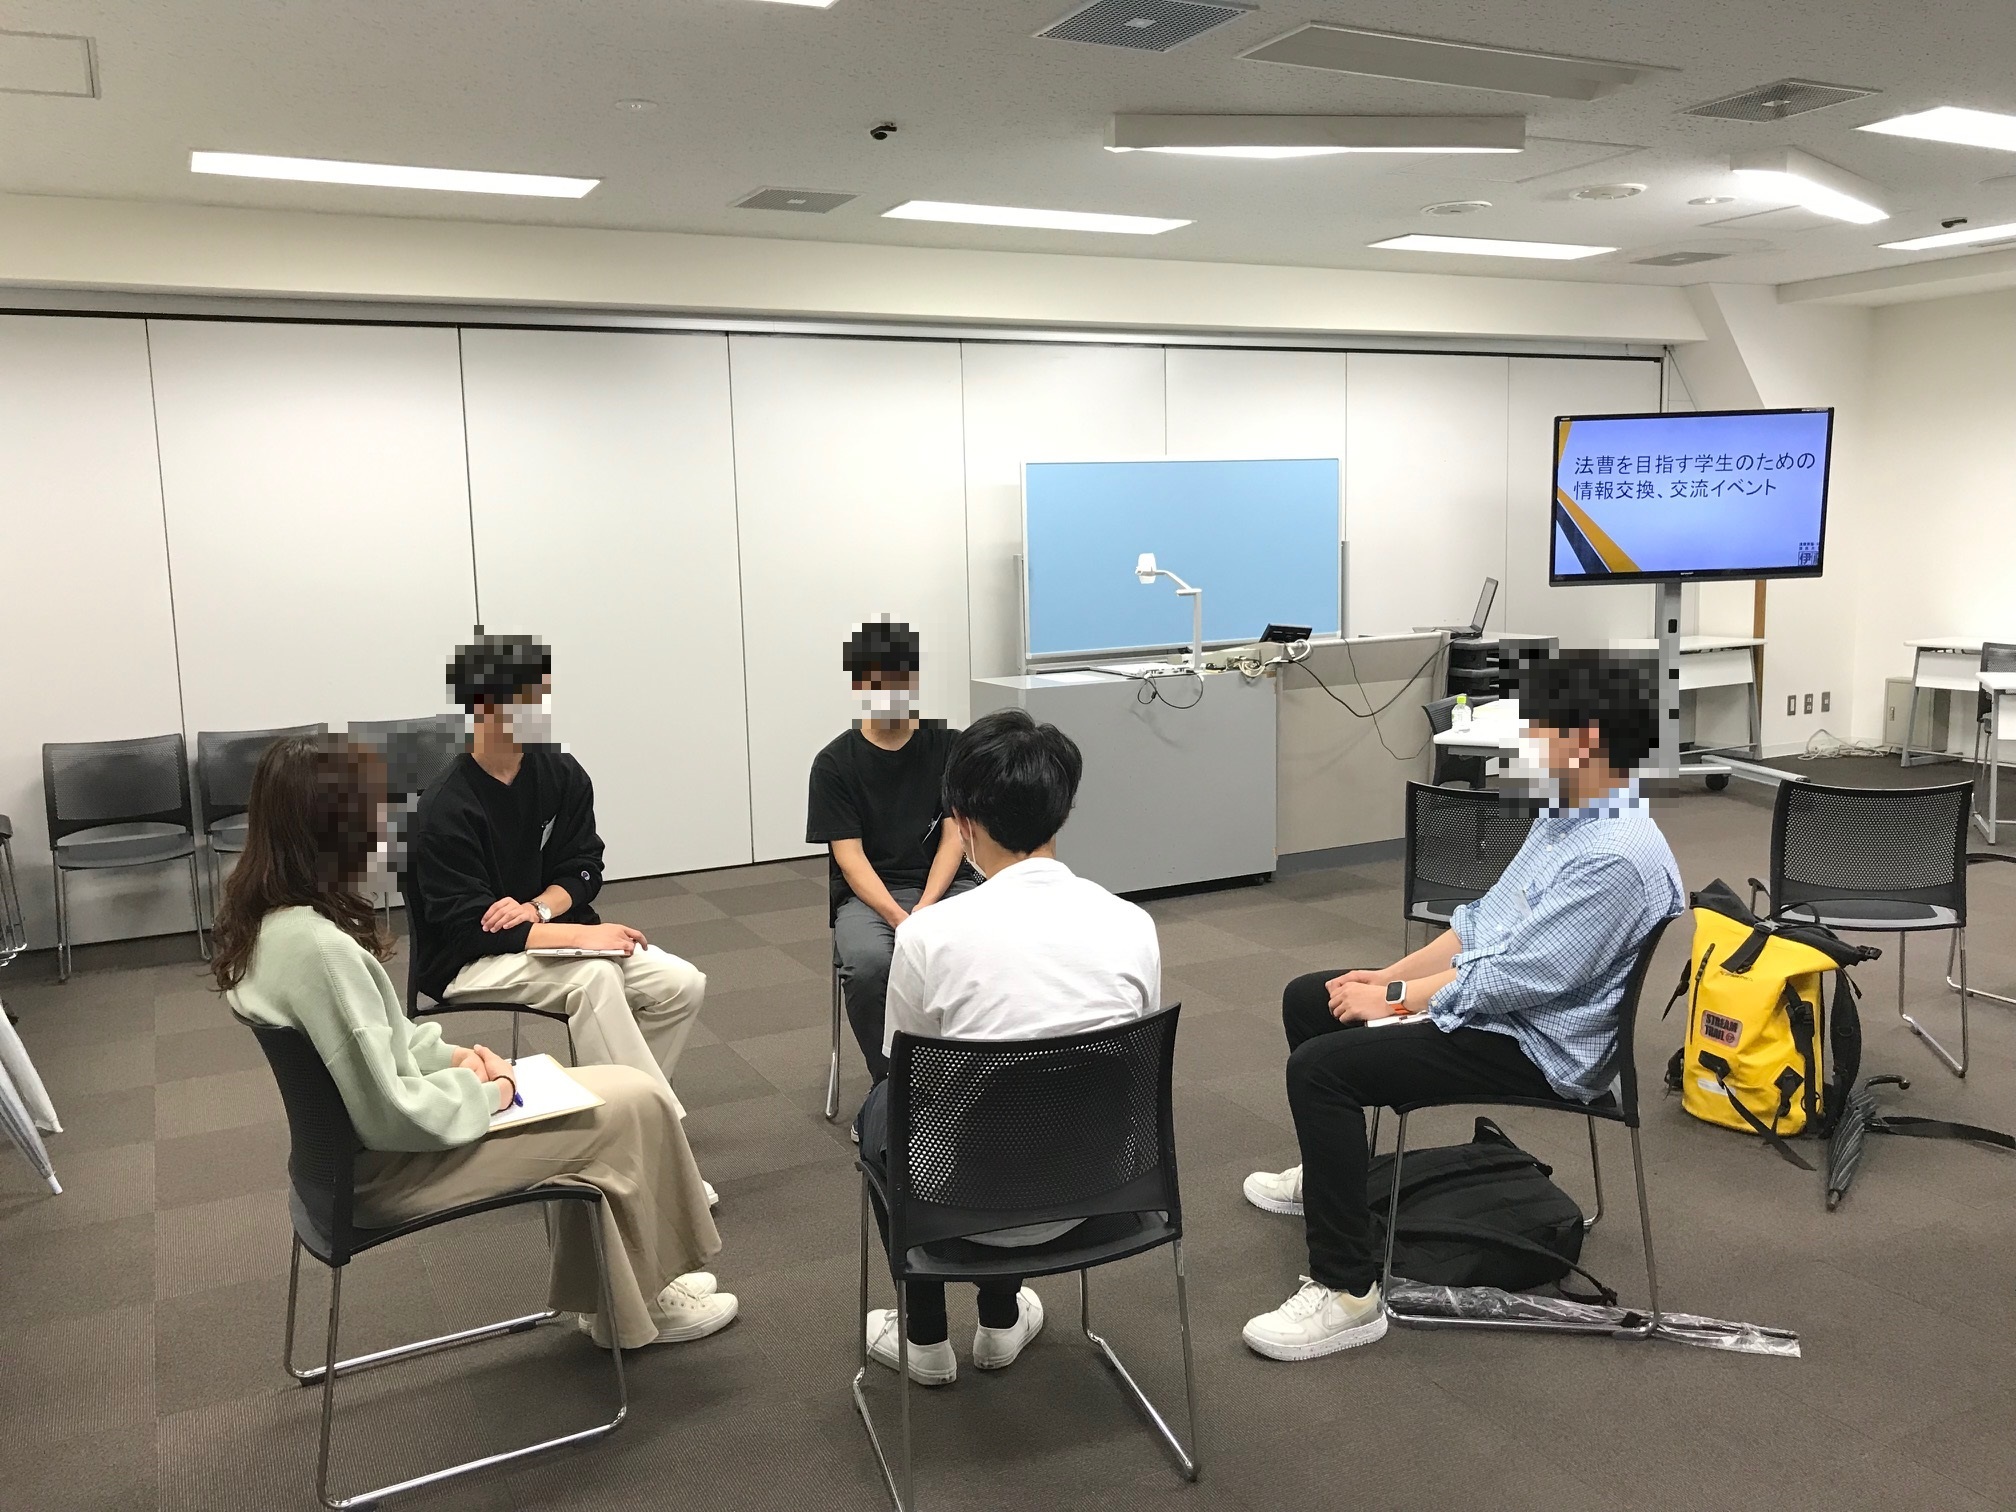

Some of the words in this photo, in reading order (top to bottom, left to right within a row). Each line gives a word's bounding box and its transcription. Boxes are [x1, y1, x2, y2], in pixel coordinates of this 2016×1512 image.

[1574, 452, 1816, 475] 法曹を目指す学生のための
[1573, 478, 1777, 501] 情報交換、交流イベント
[1705, 1024, 1725, 1041] TRAIL
[1706, 1013, 1739, 1032] STREAM
